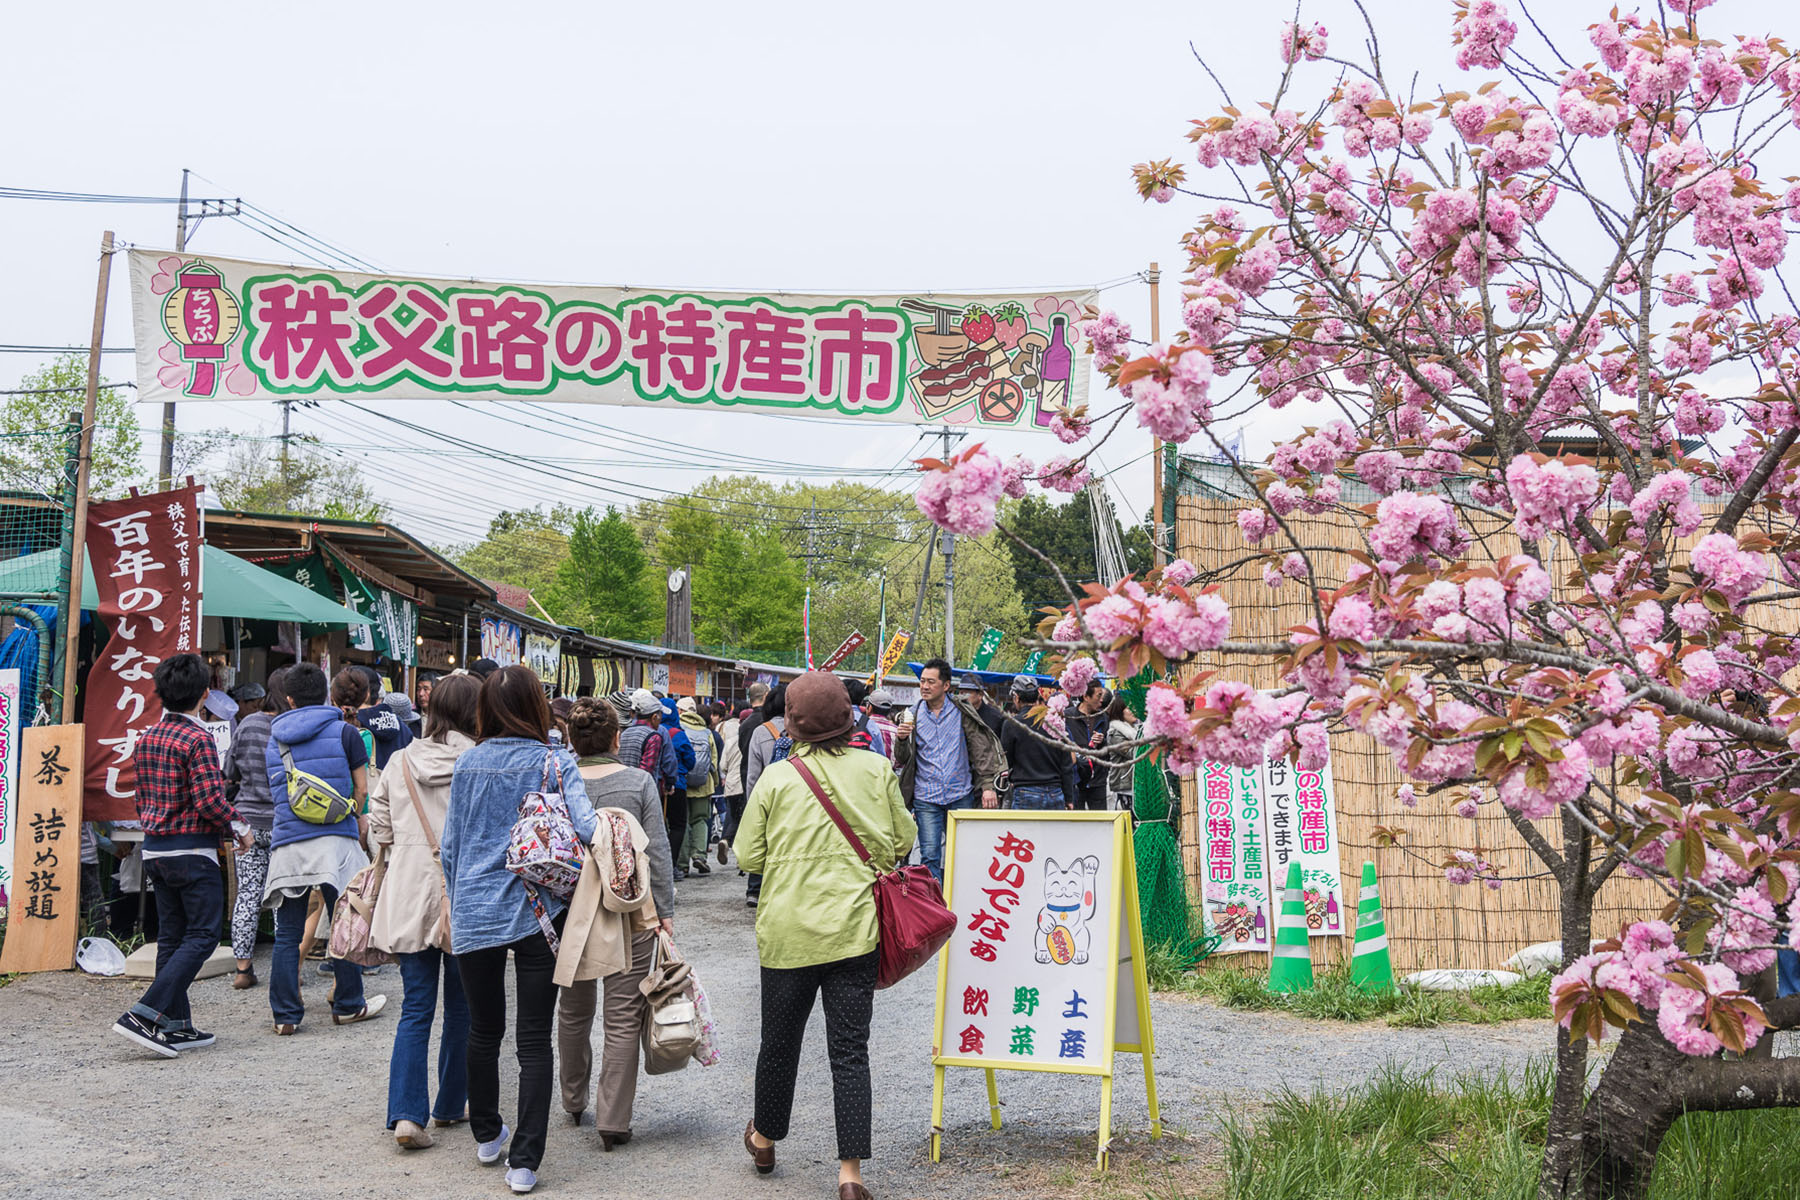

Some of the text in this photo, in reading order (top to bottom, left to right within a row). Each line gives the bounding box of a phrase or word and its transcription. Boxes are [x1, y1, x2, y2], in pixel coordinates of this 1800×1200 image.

[192, 288, 213, 344] ちちぶ
[258, 283, 899, 403] 秩父路の特産市
[167, 501, 191, 651] 秩父で育った伝統
[98, 510, 166, 798] 百年のいなりずし
[25, 745, 70, 919] 茶 詰め放題
[1271, 793, 1293, 865] できます
[1297, 762, 1326, 851] の特産市
[1227, 883, 1267, 903] 勢ぞろい
[959, 985, 989, 1056] 飲食
[1009, 986, 1039, 1056] 野菜
[1059, 990, 1088, 1059] 土産
